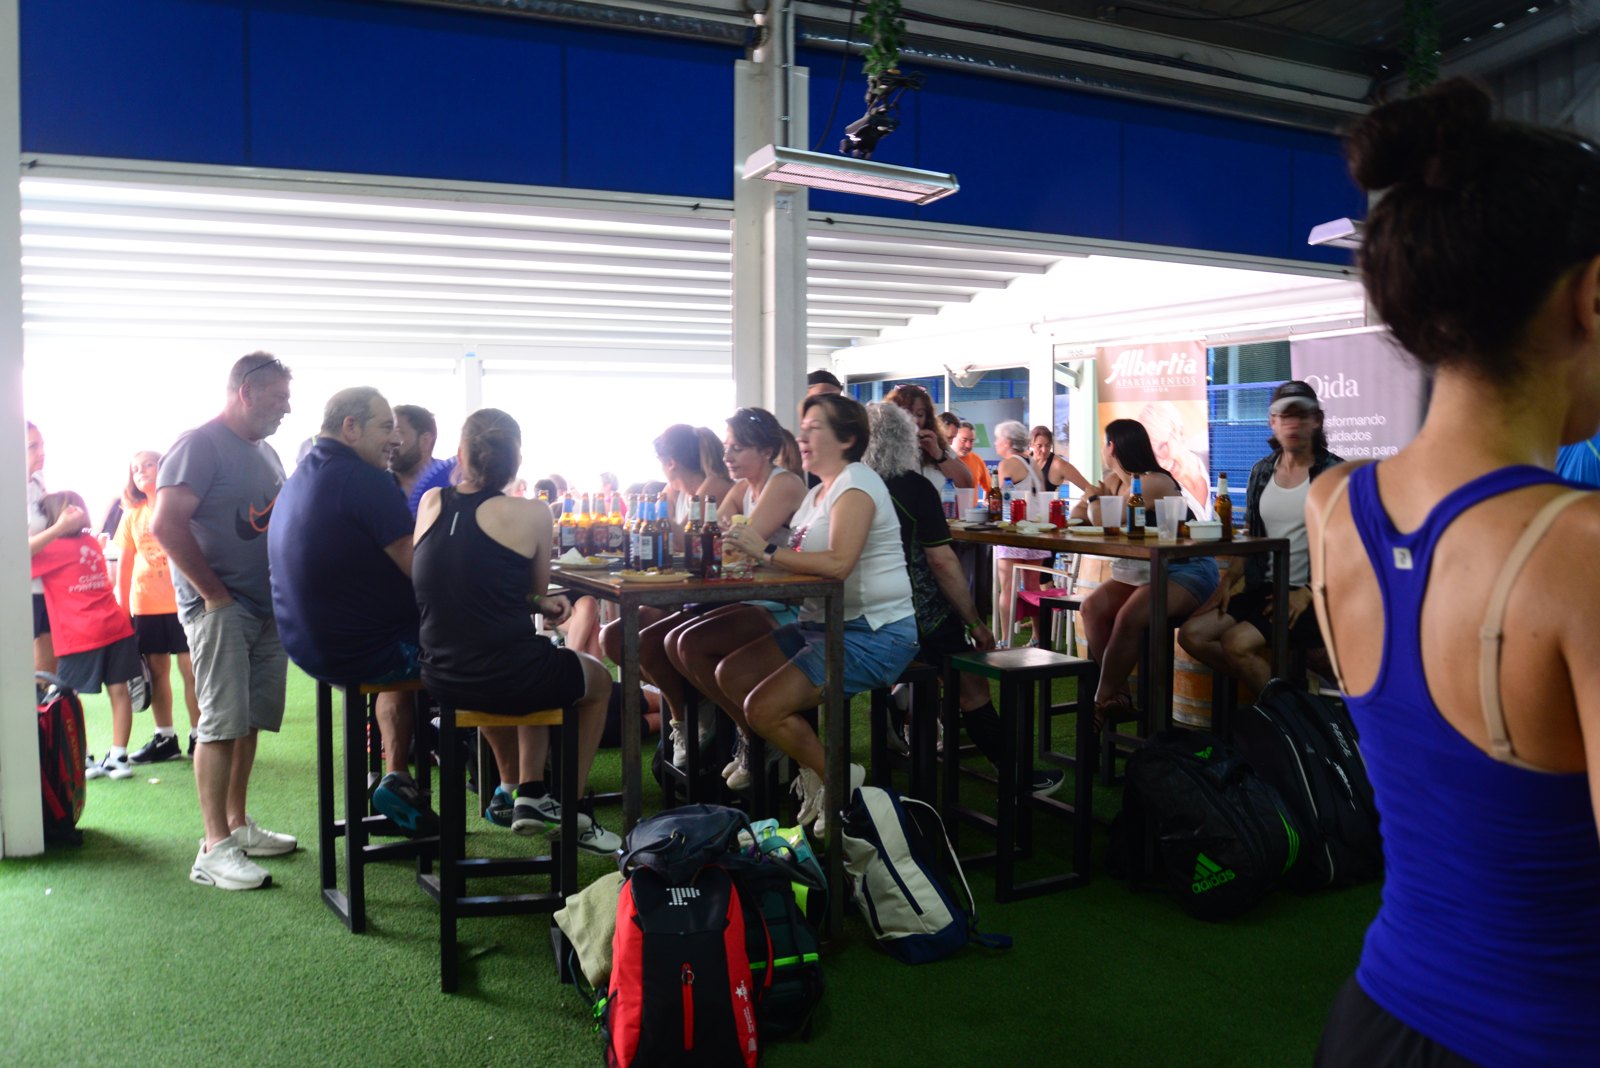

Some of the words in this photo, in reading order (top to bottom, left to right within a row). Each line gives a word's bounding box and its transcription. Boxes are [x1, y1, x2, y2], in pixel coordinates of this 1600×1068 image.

[1104, 349, 1197, 384] Albertia
[1115, 375, 1196, 387] APARTAMENTOS
[1303, 372, 1360, 402] Qida
[1327, 413, 1386, 427] sformando
[1327, 430, 1372, 442] uidados
[1328, 445, 1370, 457] ciliarios
[1372, 445, 1399, 458] para
[1191, 868, 1236, 894] adidas
